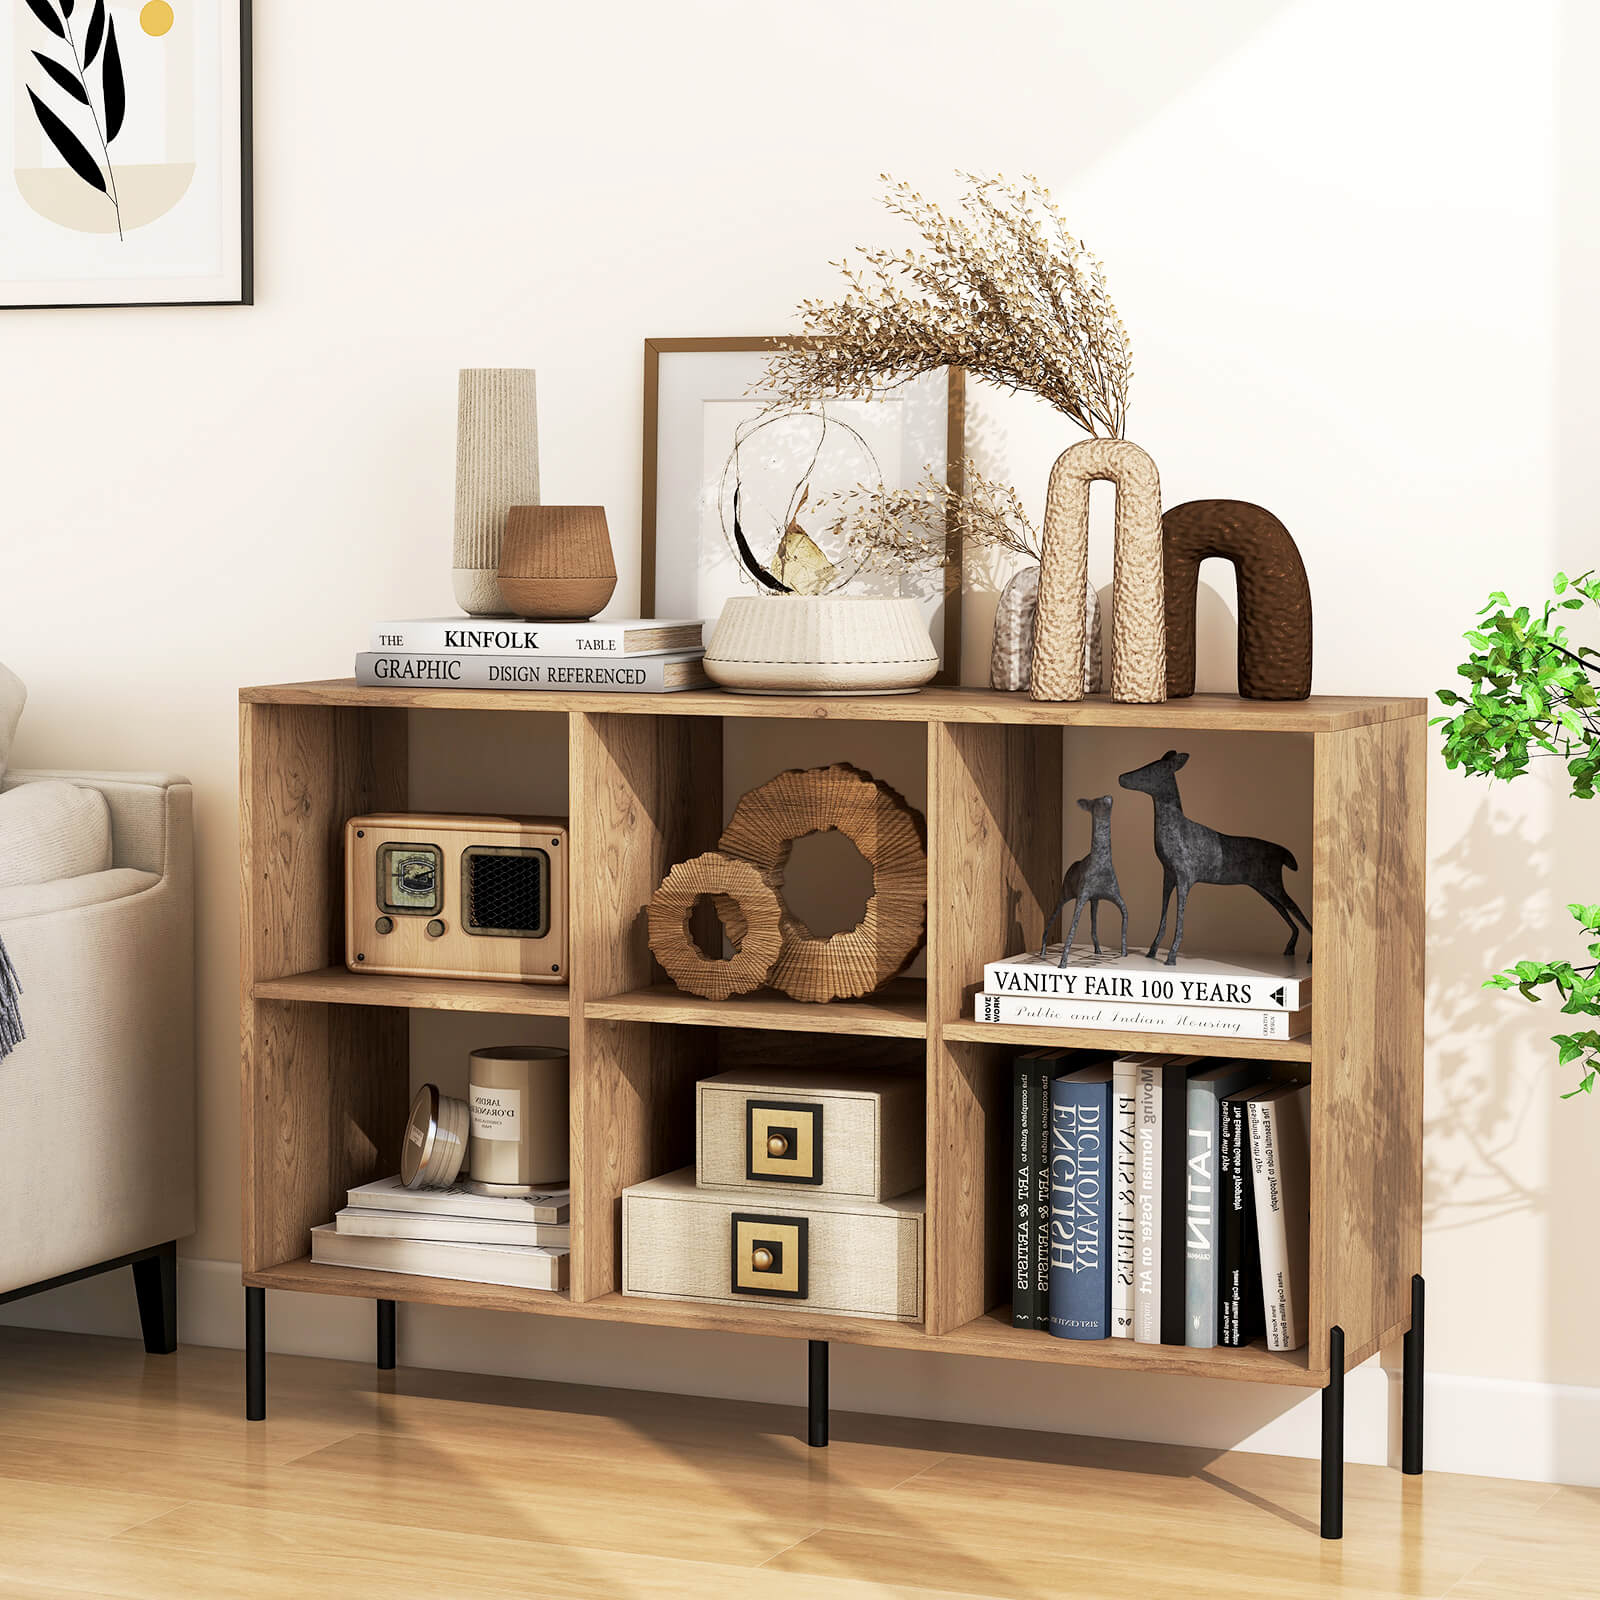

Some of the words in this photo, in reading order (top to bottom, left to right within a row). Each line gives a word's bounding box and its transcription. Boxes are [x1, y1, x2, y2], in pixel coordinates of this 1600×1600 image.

[379, 635, 404, 646] THE
[444, 630, 540, 649] KINFOLK
[575, 639, 617, 651] TABLE
[374, 658, 461, 680] GRAPHIC
[488, 666, 540, 682] DISIGN
[547, 667, 647, 685] REFERENCED
[994, 971, 1077, 994] VANITY
[1085, 976, 1134, 997] FAIR
[1141, 980, 1174, 999] 100
[1180, 981, 1252, 1004] YEARS
[984, 996, 992, 1021] MOVE
[1016, 1006, 1059, 1019] Public
[1070, 1009, 1103, 1021] and
[1112, 1009, 1166, 1025] Indian
[1176, 1015, 1242, 1033] Housing
